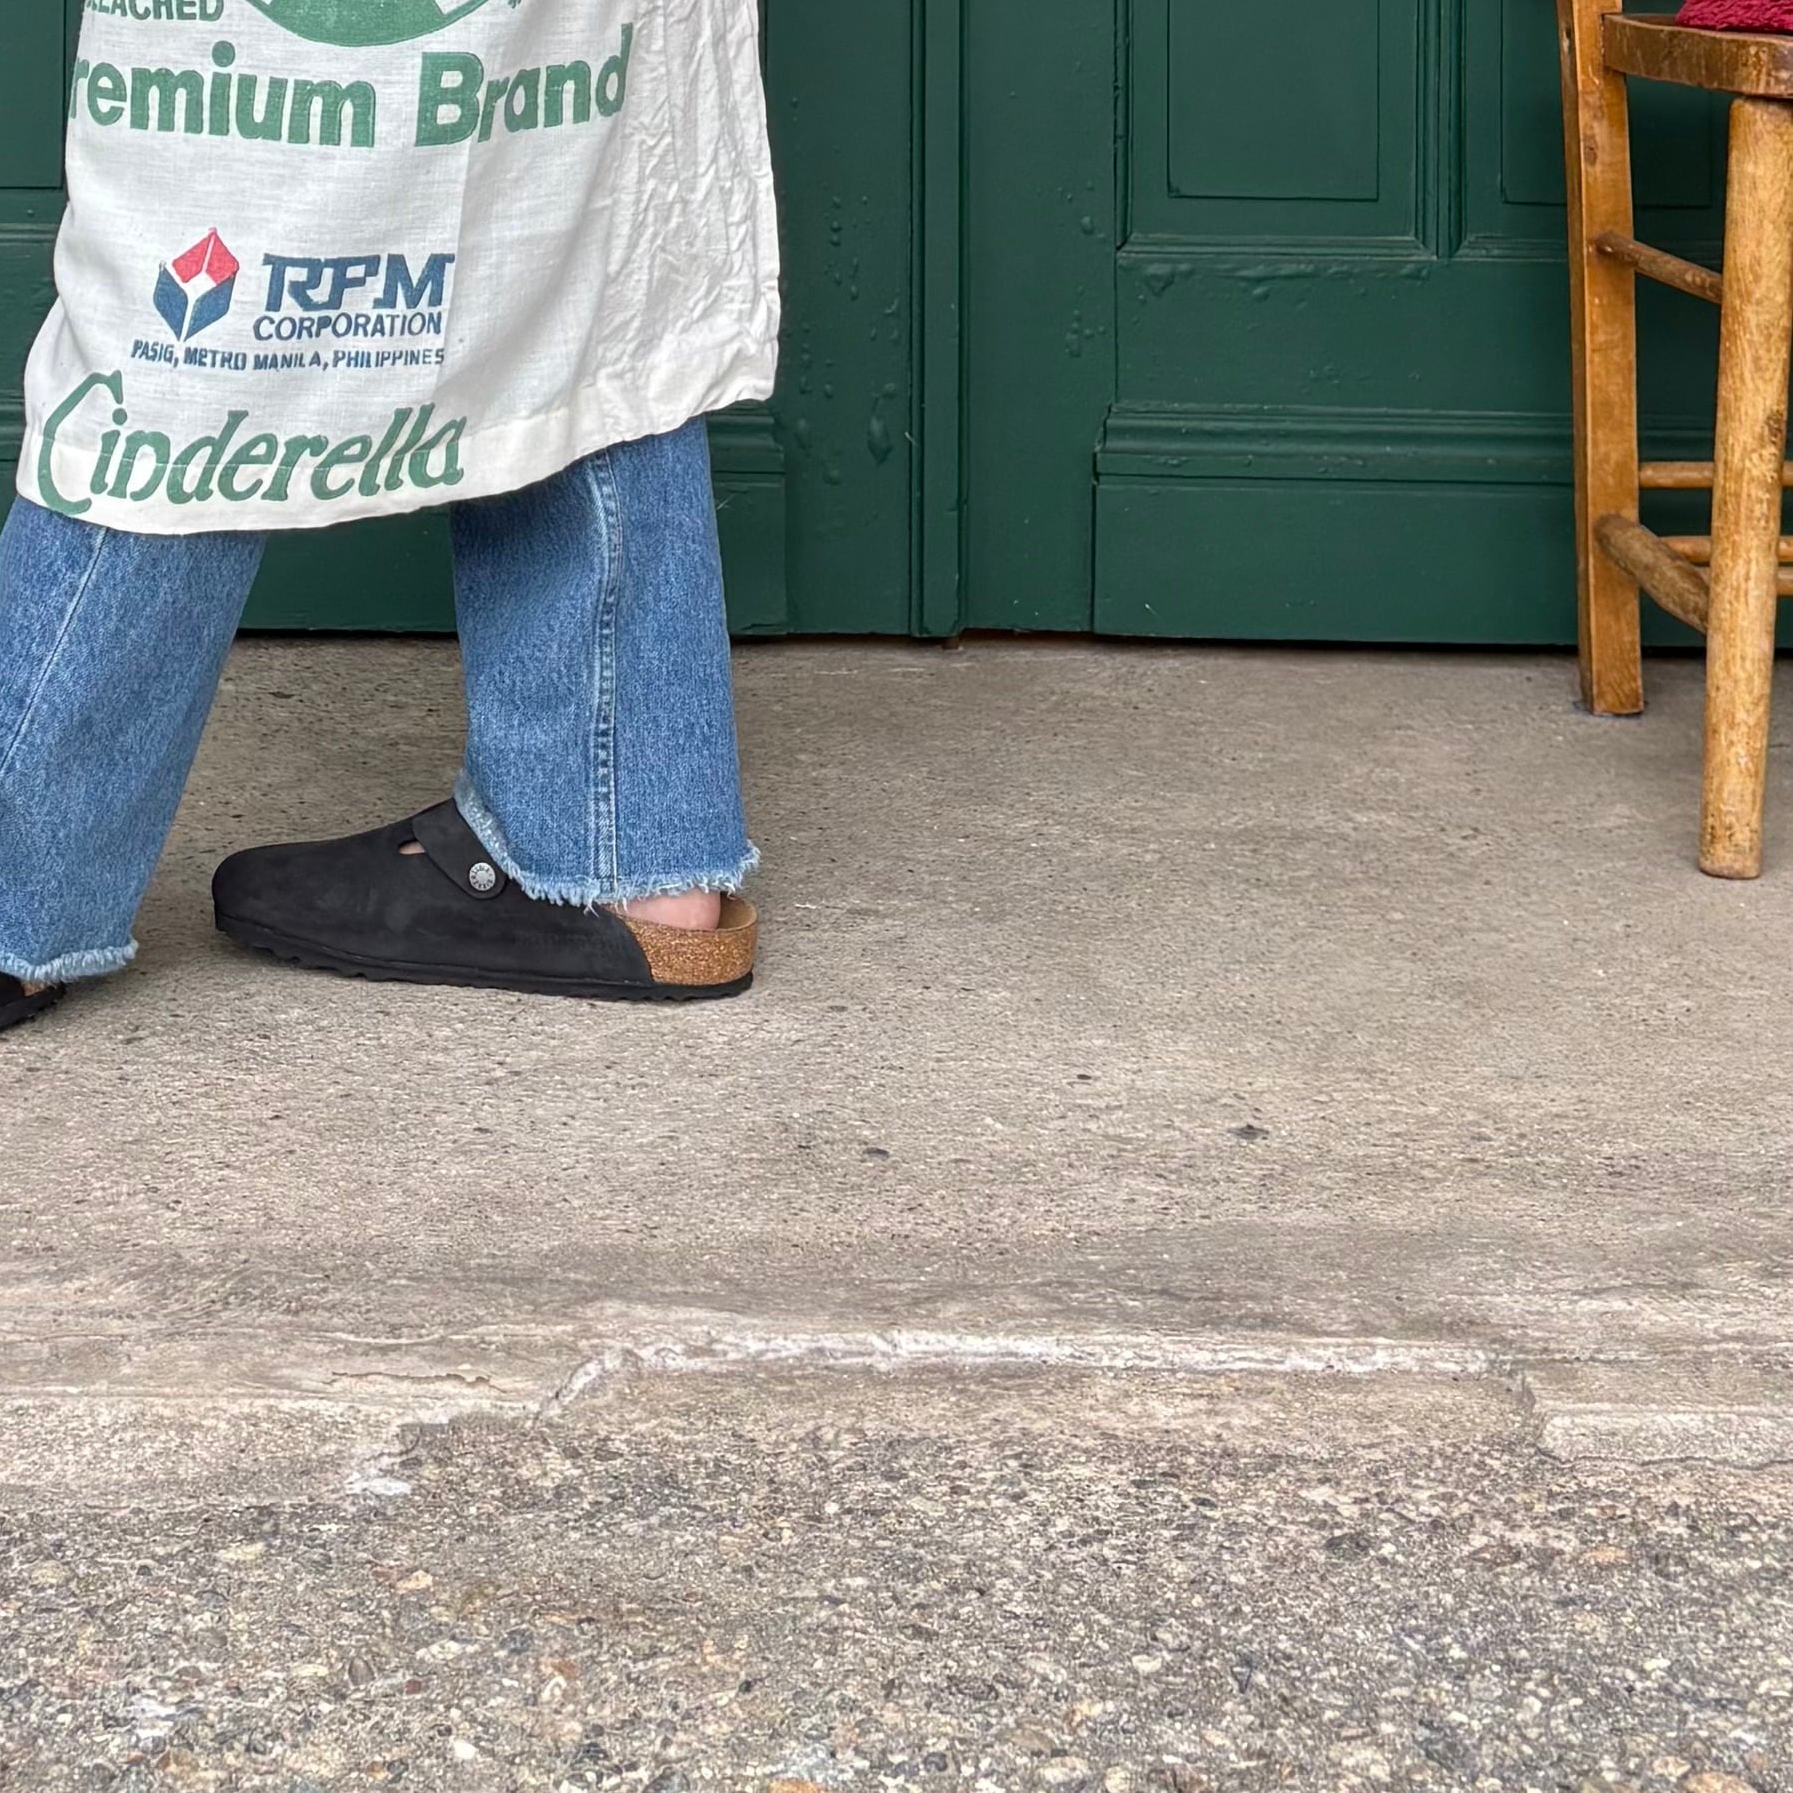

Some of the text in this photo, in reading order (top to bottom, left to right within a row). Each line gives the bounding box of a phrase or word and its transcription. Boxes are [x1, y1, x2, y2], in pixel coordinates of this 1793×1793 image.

[415, 23, 632, 147] Brand
[262, 253, 455, 312] RFM
[131, 339, 445, 372] PASIG, METRO MANILA, PHILIPPINES
[253, 312, 442, 340] CORPORATION
[37, 370, 471, 515] Cinderella
